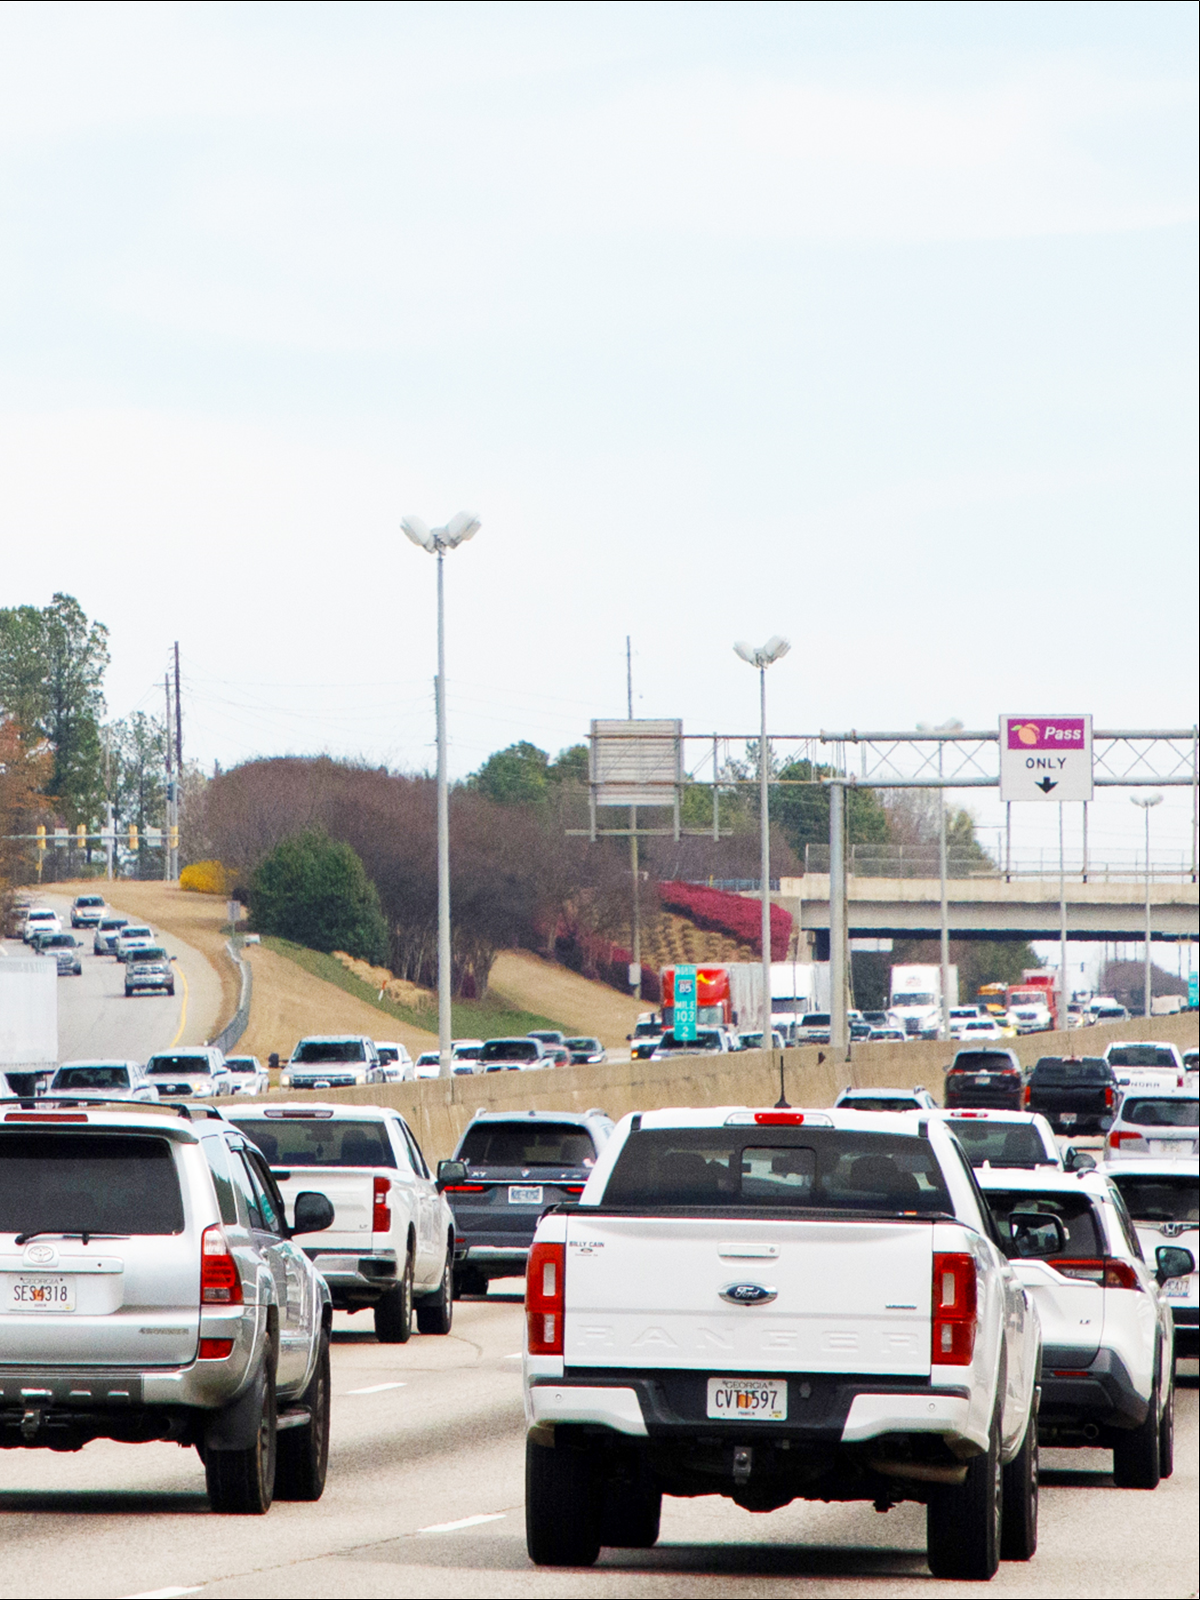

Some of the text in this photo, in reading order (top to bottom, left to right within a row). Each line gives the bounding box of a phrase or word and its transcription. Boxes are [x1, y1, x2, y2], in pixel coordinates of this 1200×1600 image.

[1044, 726, 1081, 740] Pass
[1025, 757, 1066, 769] ONLY
[675, 966, 696, 975] NORTH
[679, 984, 692, 993] 85
[675, 1001, 695, 1009] MILE
[676, 1011, 695, 1022] 103
[681, 1026, 689, 1037] 2
[13, 1285, 67, 1302] SES4318
[735, 1286, 760, 1298] Ford
[577, 1324, 920, 1354] RANGER
[725, 1381, 768, 1389] GEORGIA
[715, 1389, 778, 1409] CVT1597
